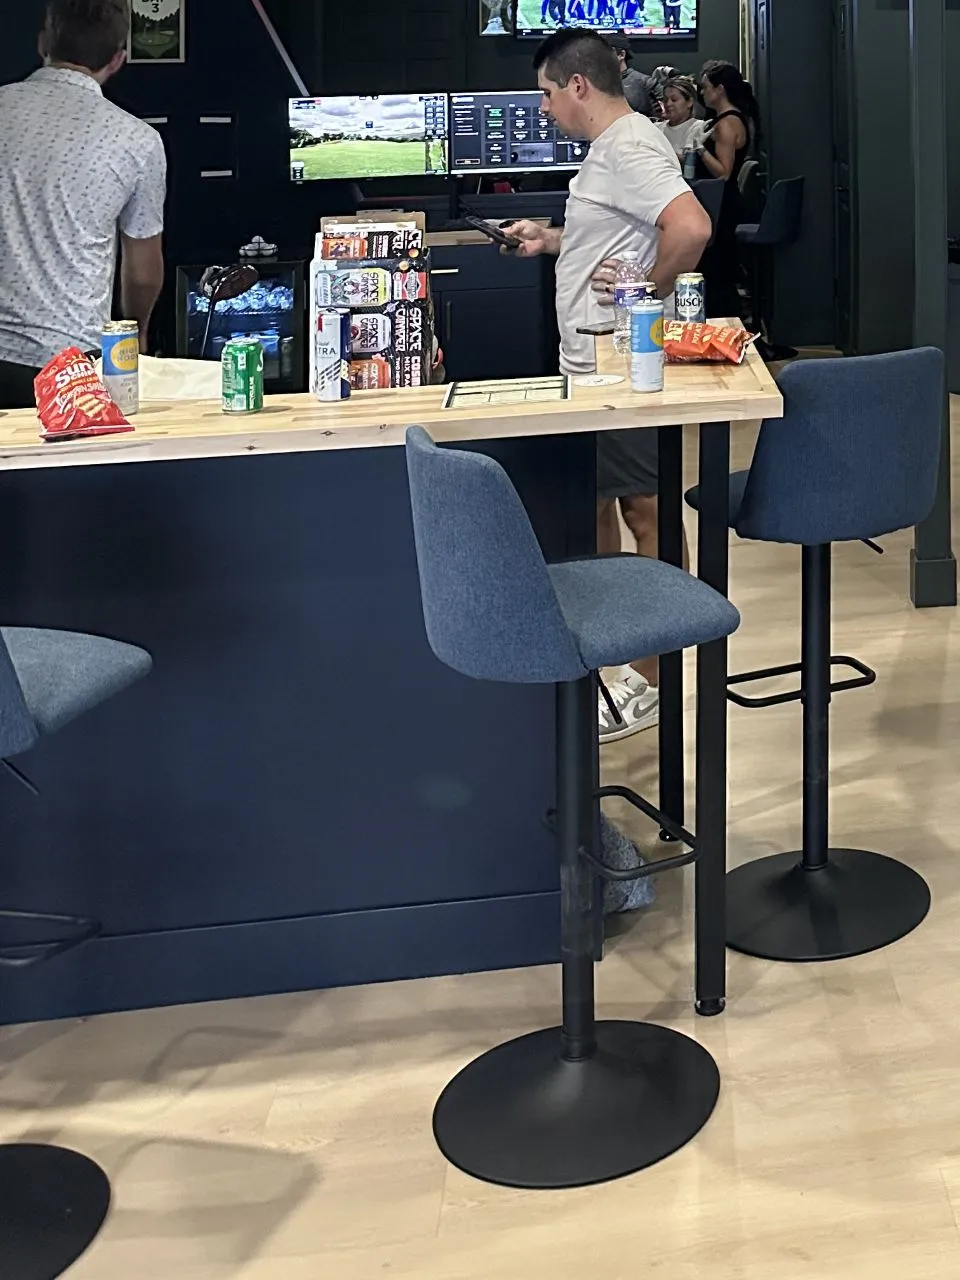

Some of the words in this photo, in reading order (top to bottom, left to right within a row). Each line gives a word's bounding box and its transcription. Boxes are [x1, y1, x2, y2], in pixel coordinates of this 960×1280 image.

[151, 3, 160, 13] 3
[674, 297, 703, 308] BUSCH
[395, 308, 406, 352] CAMPER
[409, 307, 422, 352] SPACE
[55, 361, 95, 389] Sun
[411, 355, 421, 387] COSM
